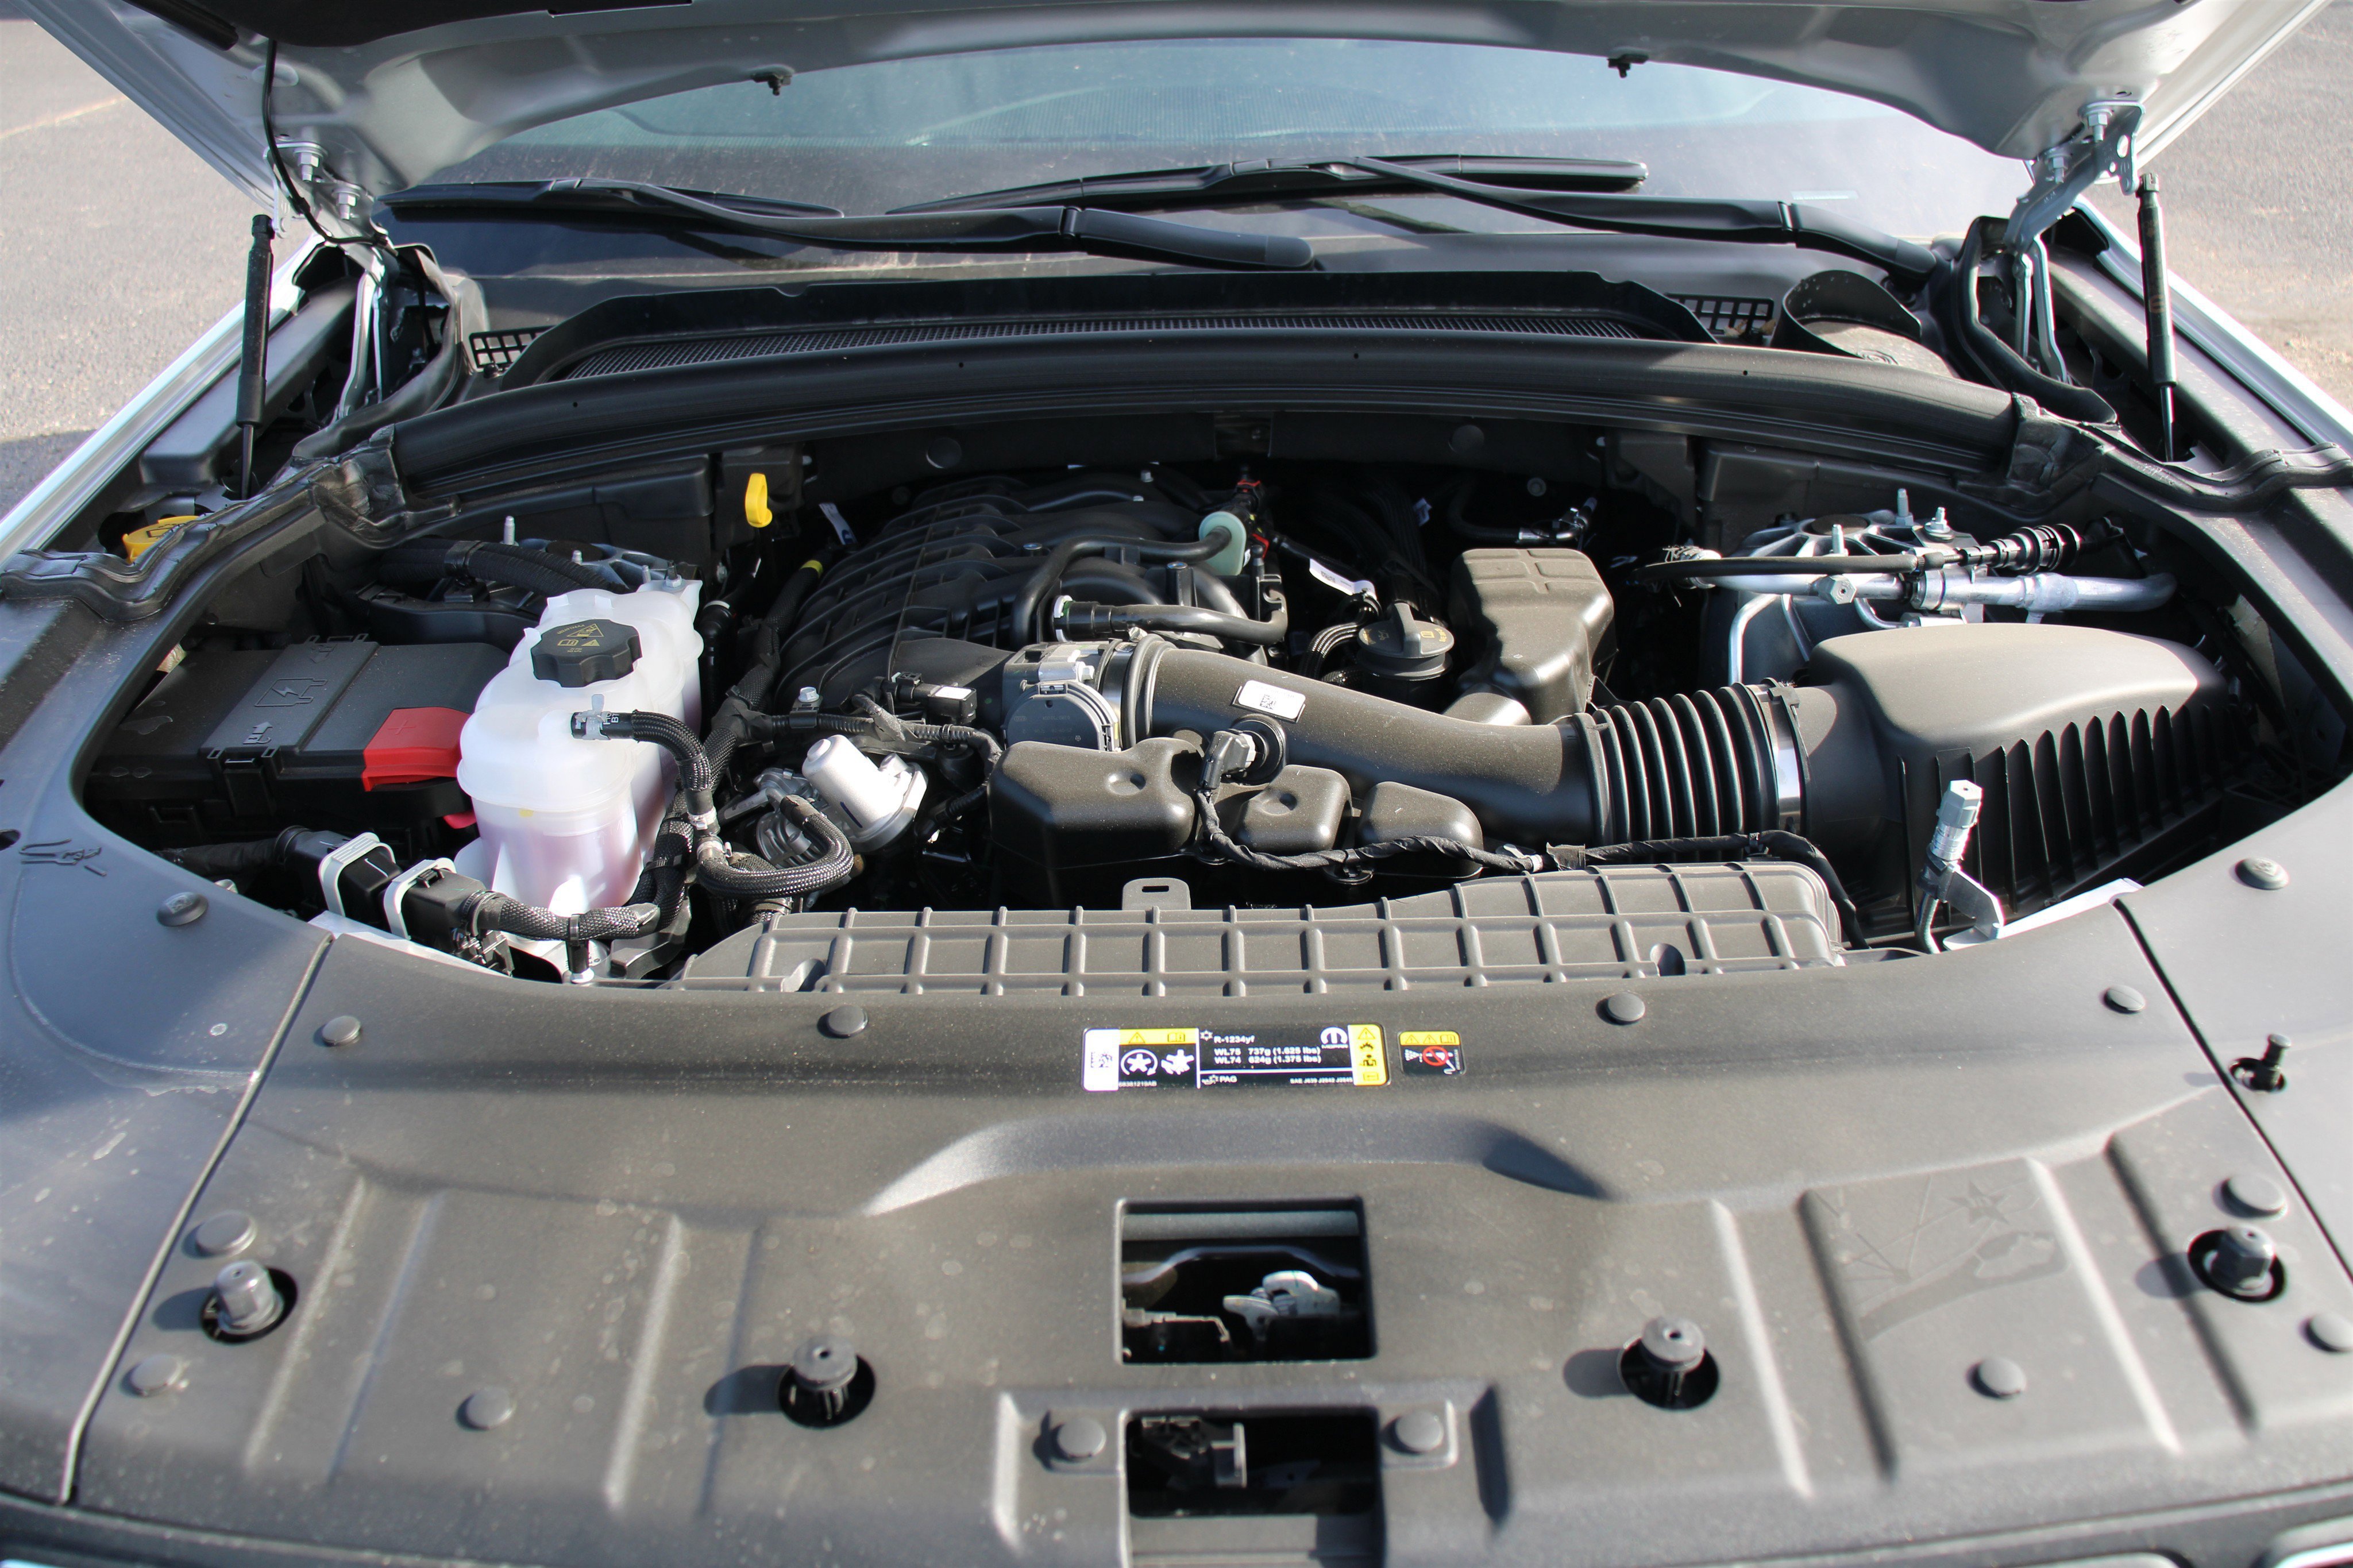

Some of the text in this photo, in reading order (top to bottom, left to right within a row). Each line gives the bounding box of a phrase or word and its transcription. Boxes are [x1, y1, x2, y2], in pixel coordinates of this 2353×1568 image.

[1214, 1035, 1255, 1044] R-1234yf
[1214, 1046, 1321, 1056] WL75 737g (1.625 lbs)
[1214, 1054, 1321, 1064] WL74 624g (1.375 lbs)
[1219, 1075, 1237, 1083] PAG
